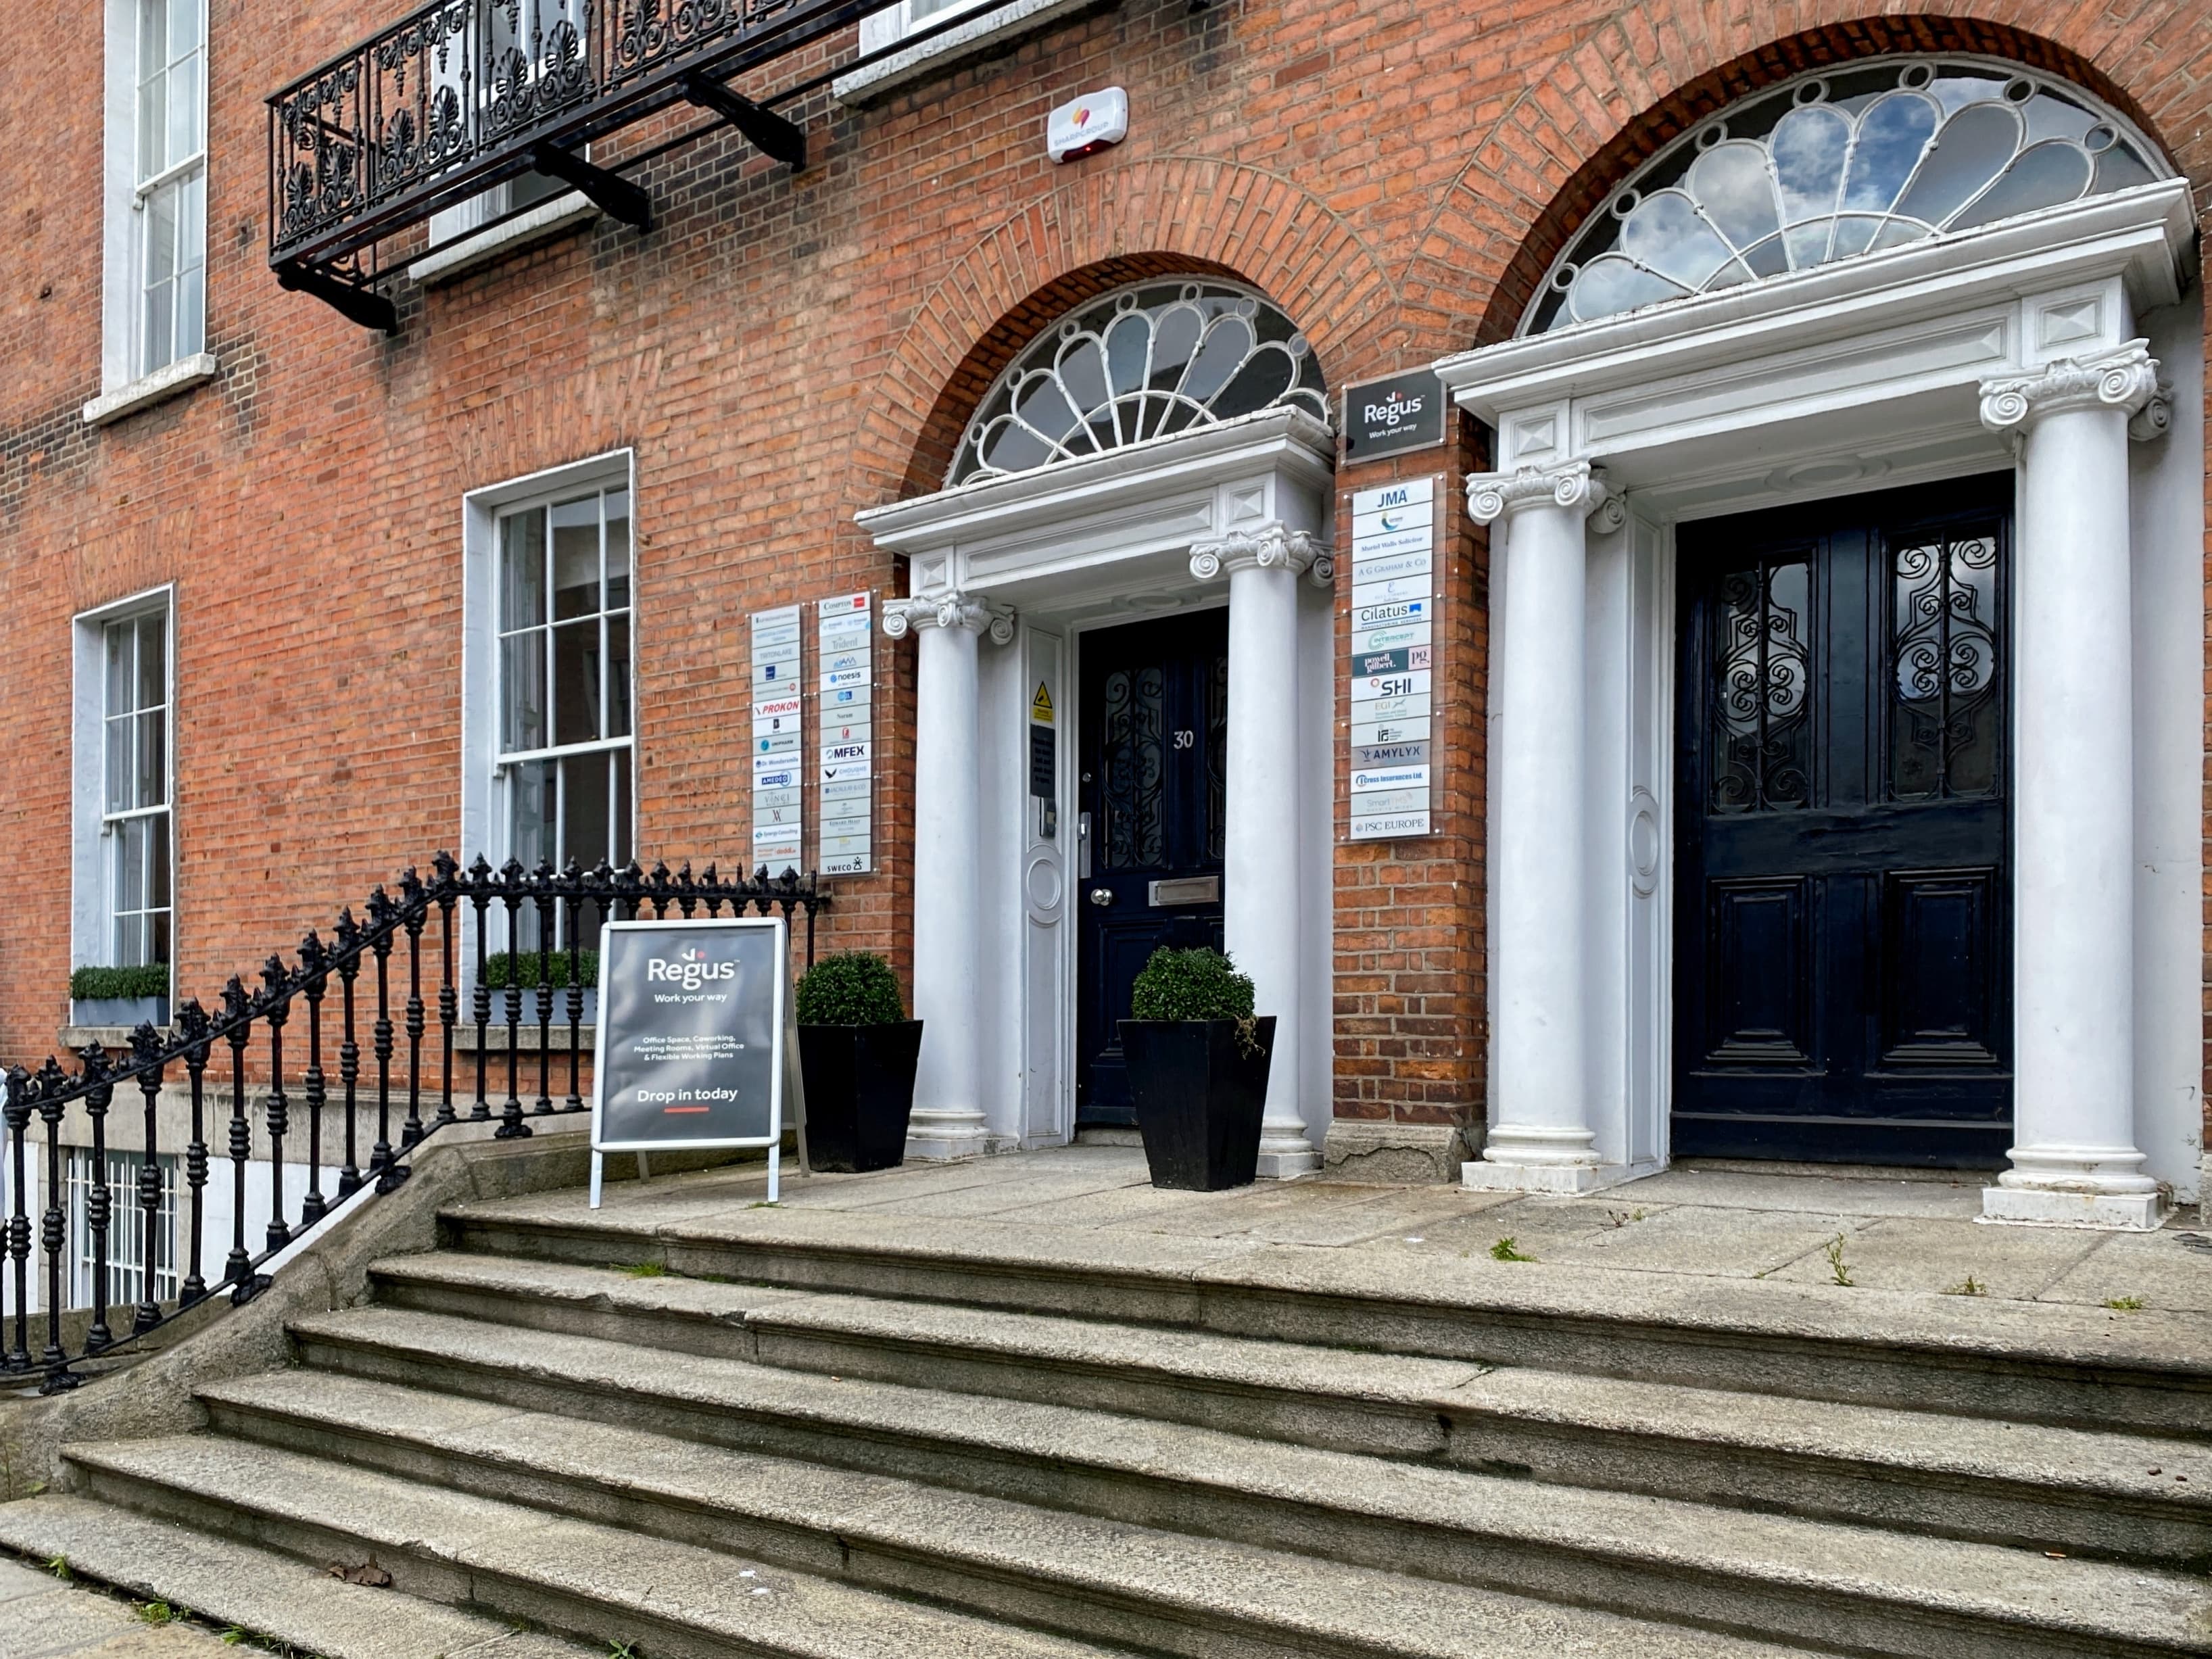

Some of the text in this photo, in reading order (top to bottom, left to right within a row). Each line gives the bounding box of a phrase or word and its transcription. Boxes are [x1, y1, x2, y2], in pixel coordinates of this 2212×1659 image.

[1364, 395, 1422, 425] Regus
[1368, 423, 1417, 439] Work your way
[1377, 489, 1408, 508] JMA
[1358, 569, 1364, 577] A
[1366, 567, 1372, 575] G
[1362, 605, 1408, 621] Cilatus
[832, 638, 858, 650] Trident
[1374, 632, 1414, 643] INTERCEPT
[1365, 653, 1390, 667] powell
[838, 671, 861, 680] noesis
[1380, 678, 1412, 697] SHI
[763, 700, 799, 714] PROKON
[1173, 730, 1194, 750] 30
[834, 745, 865, 759] MFEX
[1374, 746, 1421, 759] AMYLYX
[763, 775, 788, 784] AMEDEO
[1380, 774, 1412, 782] Insurances
[1365, 819, 1424, 832] PSC EUROPE
[648, 957, 736, 990] Regus
[654, 993, 727, 1005] Work your way
[643, 1036, 665, 1044] Office
[634, 1045, 665, 1055] Meeting
[651, 1053, 679, 1061] Flexible
[681, 1052, 712, 1061] Working
[638, 1088, 738, 1103] Drop in today
